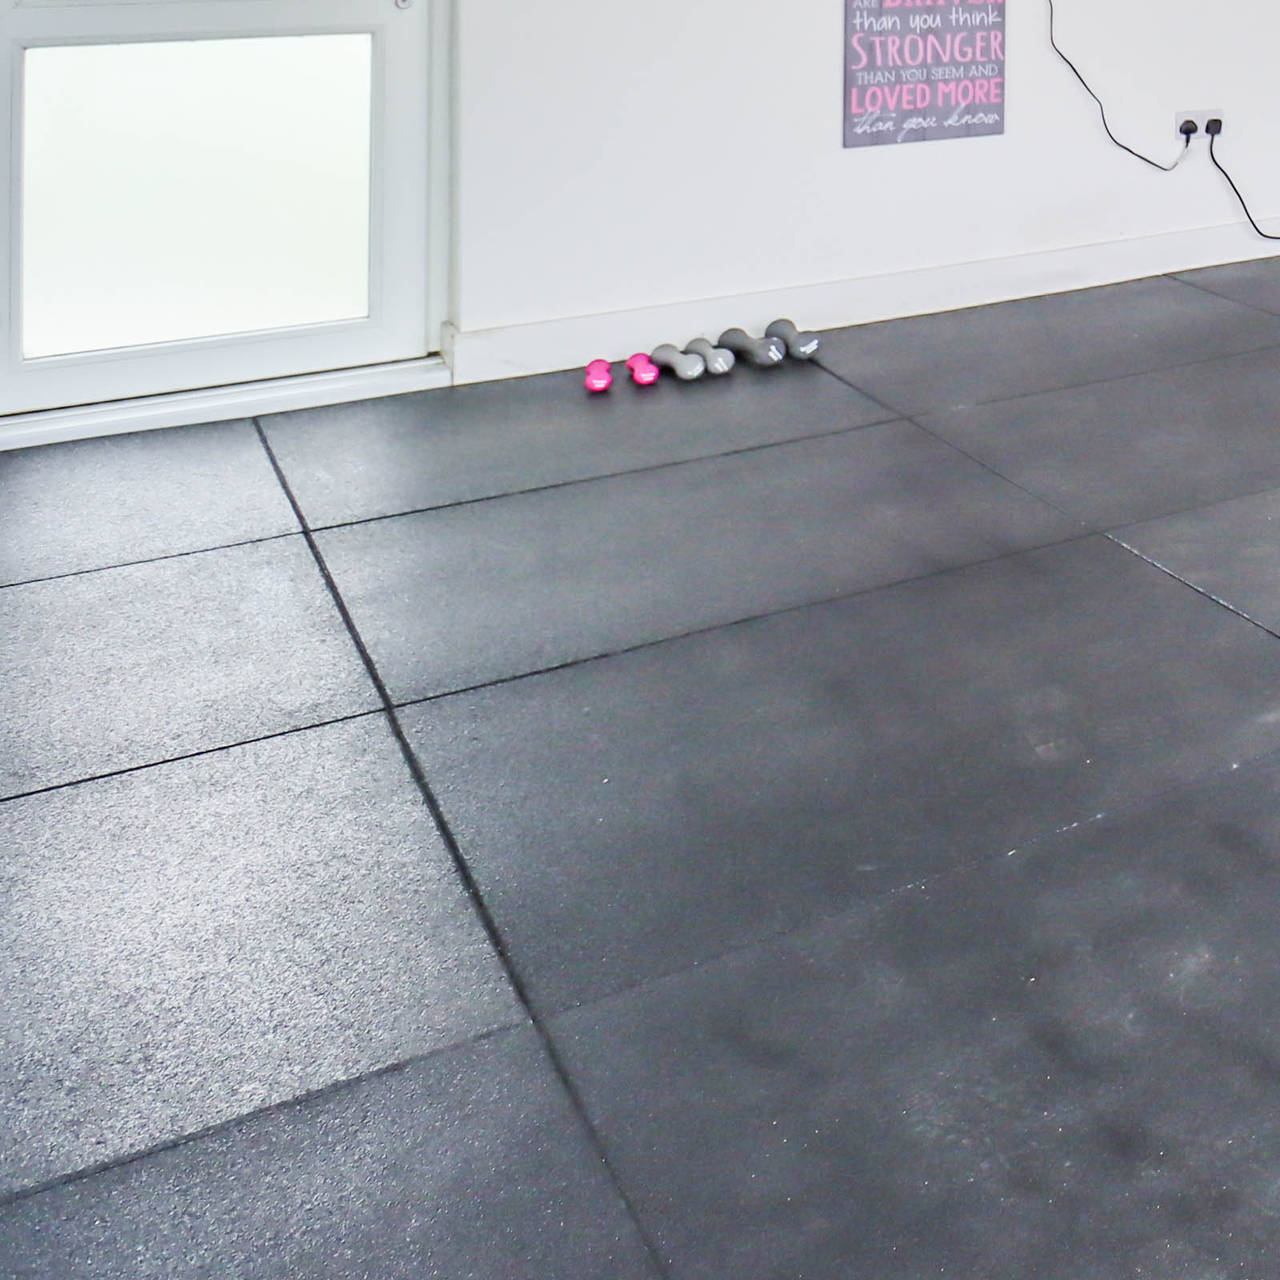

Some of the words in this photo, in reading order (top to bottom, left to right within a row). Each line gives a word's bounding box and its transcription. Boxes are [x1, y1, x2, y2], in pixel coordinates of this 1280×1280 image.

[853, 11, 901, 32] than
[909, 14, 942, 34] you
[950, 3, 1002, 27] think
[851, 30, 1005, 70] STRONGER
[856, 70, 896, 85] THAN
[901, 69, 927, 81] YOU
[931, 66, 964, 80] SEEM
[969, 64, 999, 77] AND
[851, 83, 931, 114] LOVED
[937, 77, 1004, 108] MORE
[853, 108, 897, 135] than
[897, 117, 938, 143] you
[944, 104, 1000, 128] know
